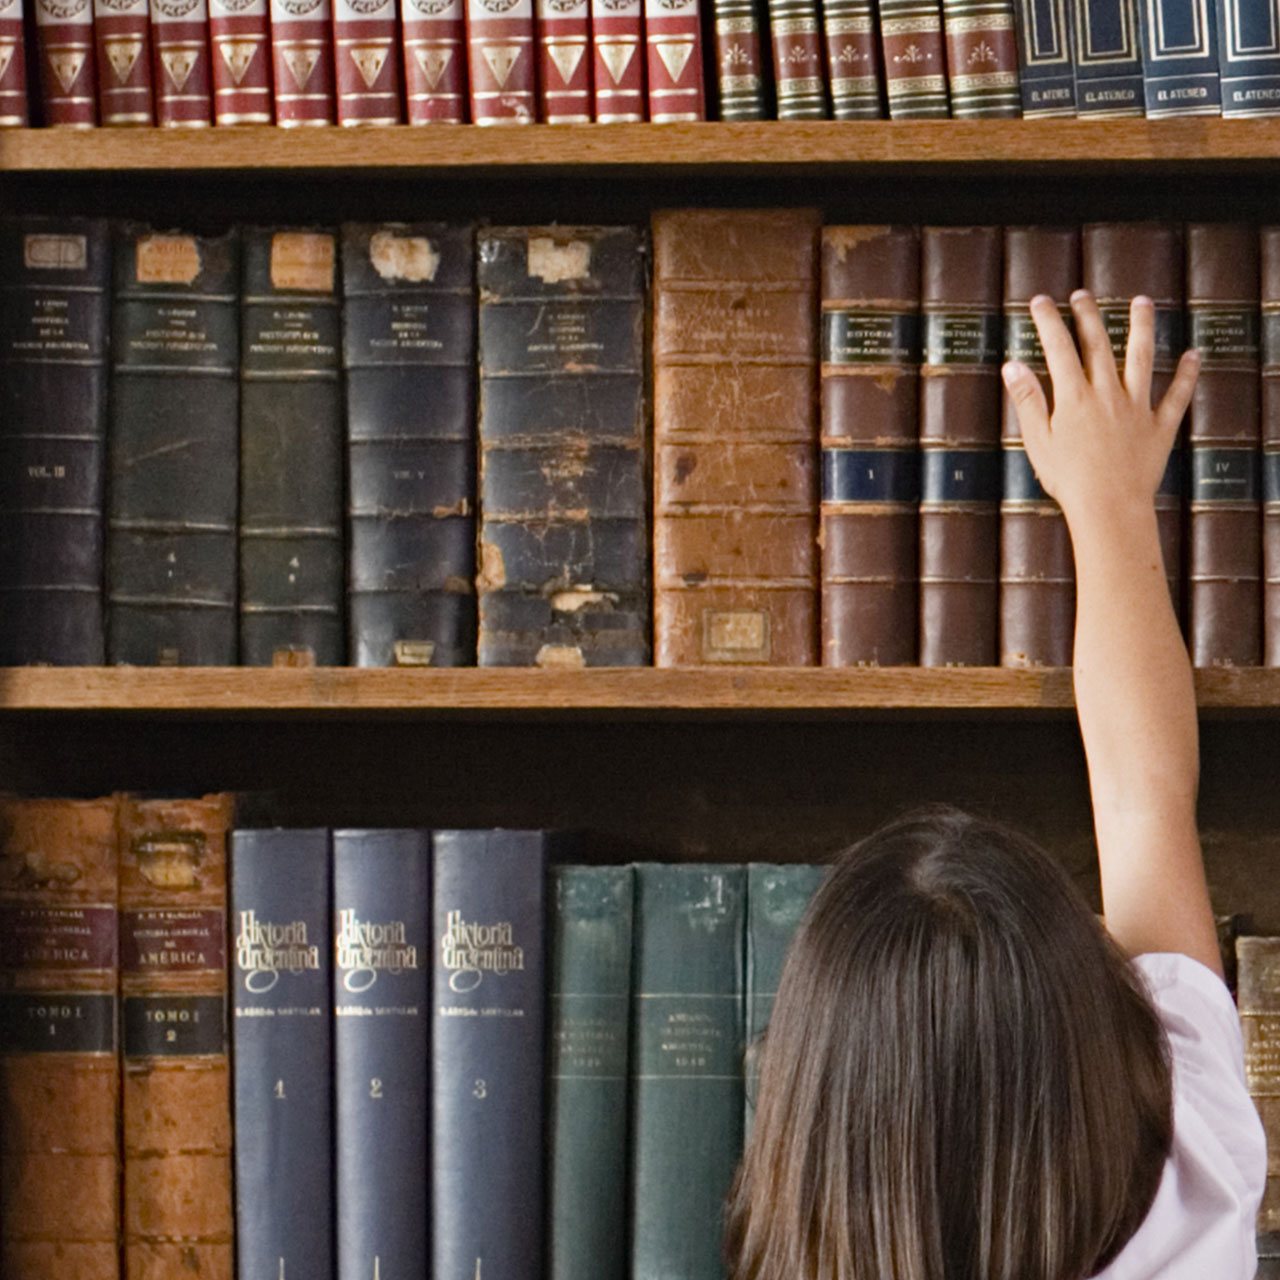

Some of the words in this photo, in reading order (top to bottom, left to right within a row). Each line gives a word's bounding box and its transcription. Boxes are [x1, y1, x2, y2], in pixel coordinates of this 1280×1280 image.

[1085, 91, 1097, 103] EL
[1098, 89, 1134, 101] ATENEO
[1157, 89, 1169, 101] EL
[1170, 87, 1208, 99] ATENEO
[1233, 90, 1244, 102] EL
[239, 909, 307, 948] Historia
[339, 908, 406, 947] Historia
[445, 909, 512, 947] Historia
[236, 936, 320, 993] Argentina
[336, 936, 418, 993] Argentina
[442, 936, 524, 993] Argentina
[146, 1010, 190, 1022] TOMO
[274, 1079, 286, 1099] 1
[369, 1077, 383, 1099] 2
[473, 1079, 487, 1099] 3
